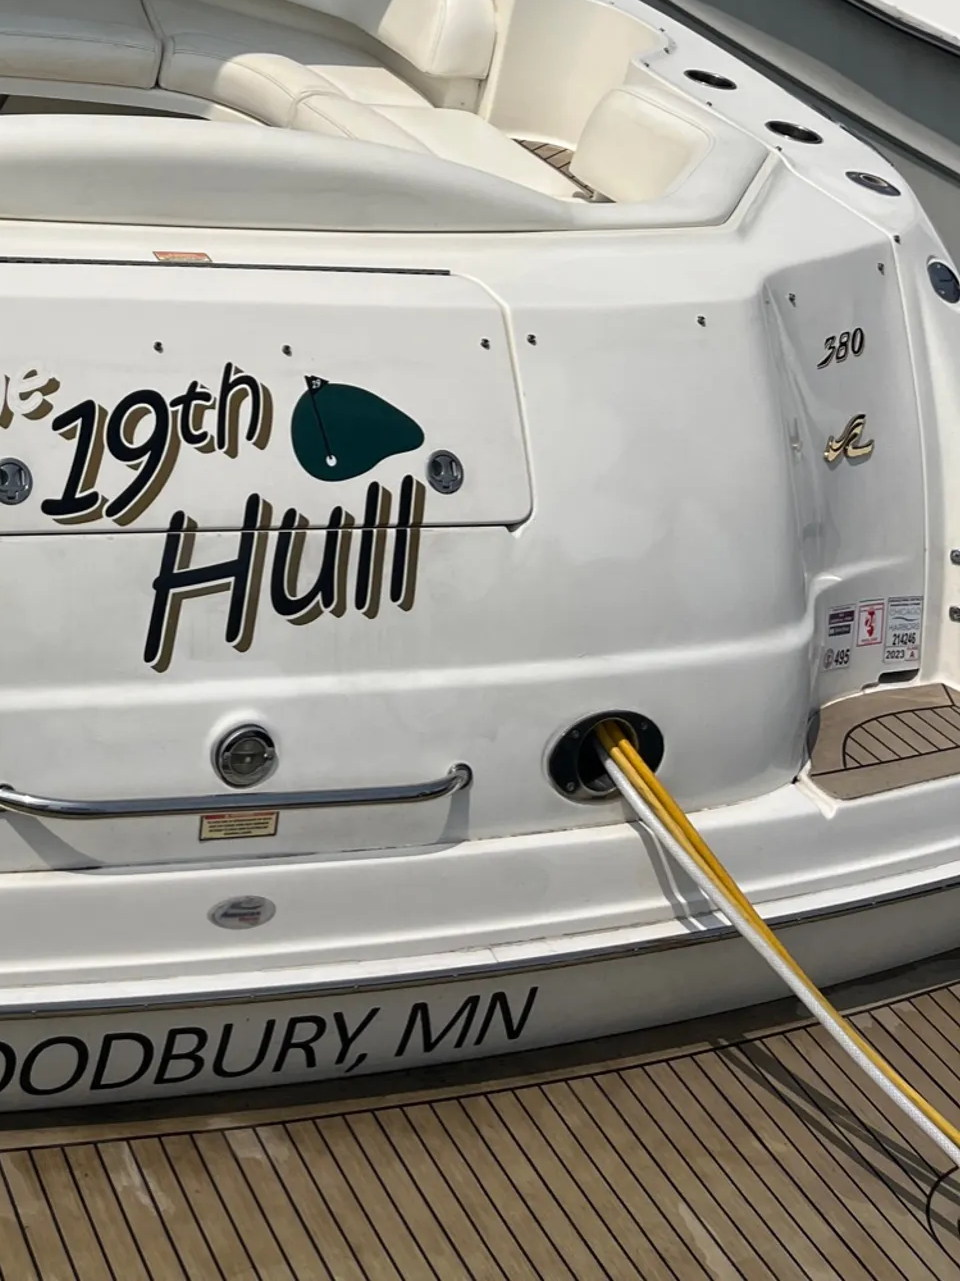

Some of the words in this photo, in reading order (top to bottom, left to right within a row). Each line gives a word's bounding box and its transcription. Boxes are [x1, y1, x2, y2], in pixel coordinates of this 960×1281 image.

[817, 327, 865, 370] 380
[41, 361, 273, 525] 19th
[143, 475, 425, 673] Hull
[834, 649, 850, 666] 495
[886, 649, 905, 659] 2023
[396, 987, 538, 1057] MN
